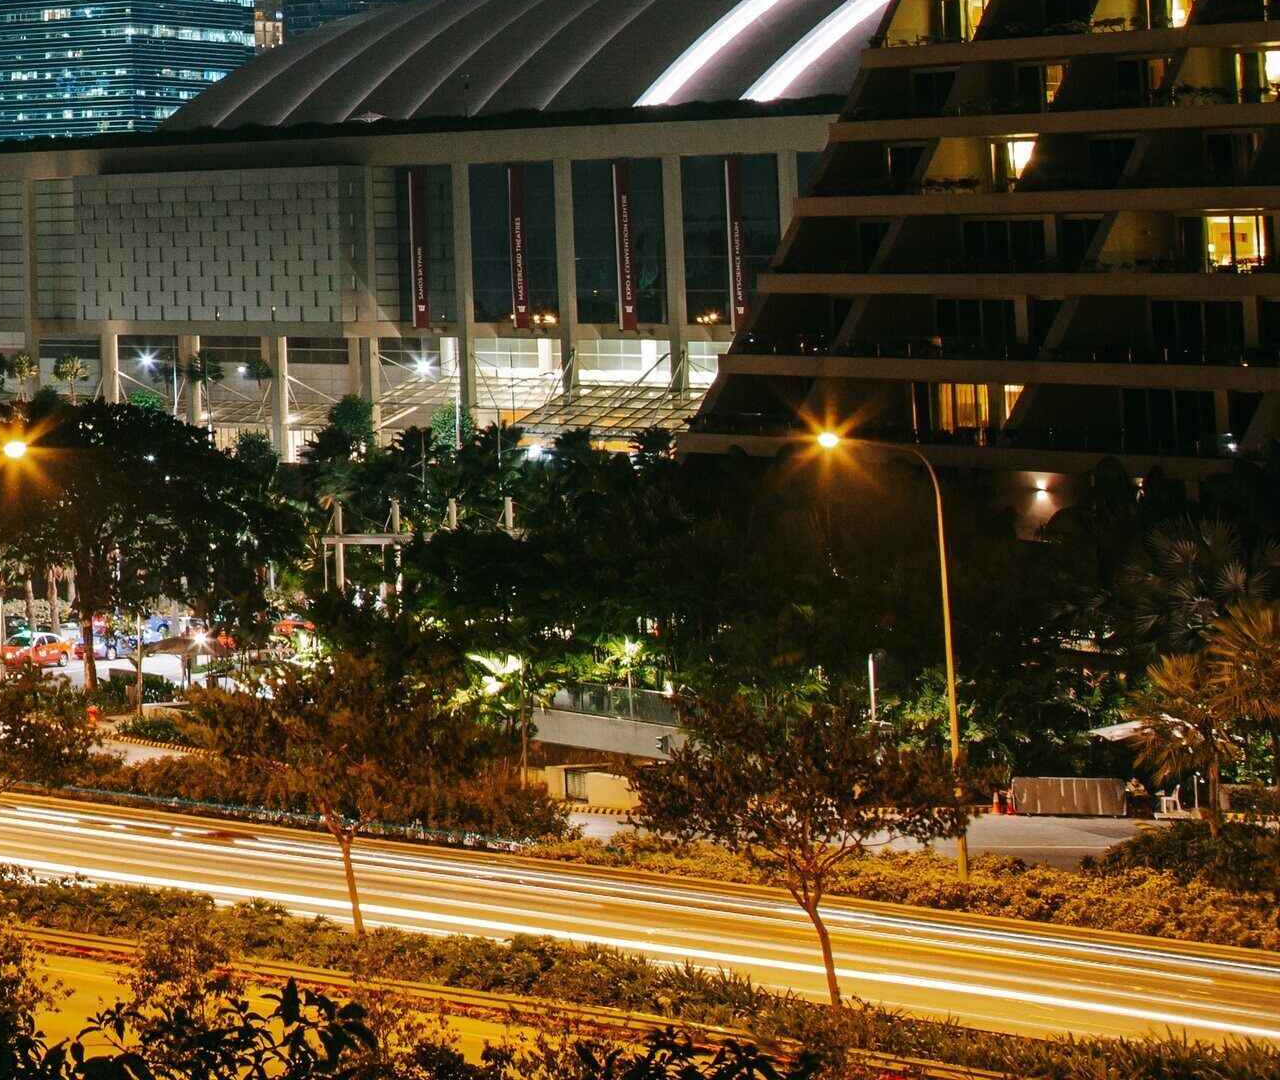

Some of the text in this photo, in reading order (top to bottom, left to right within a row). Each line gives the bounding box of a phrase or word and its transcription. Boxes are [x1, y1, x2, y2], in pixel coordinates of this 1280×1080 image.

[623, 223, 631, 273] CONVENTION
[516, 253, 524, 301] MASTERCARD
[735, 256, 743, 301] ARTSCIENCE
